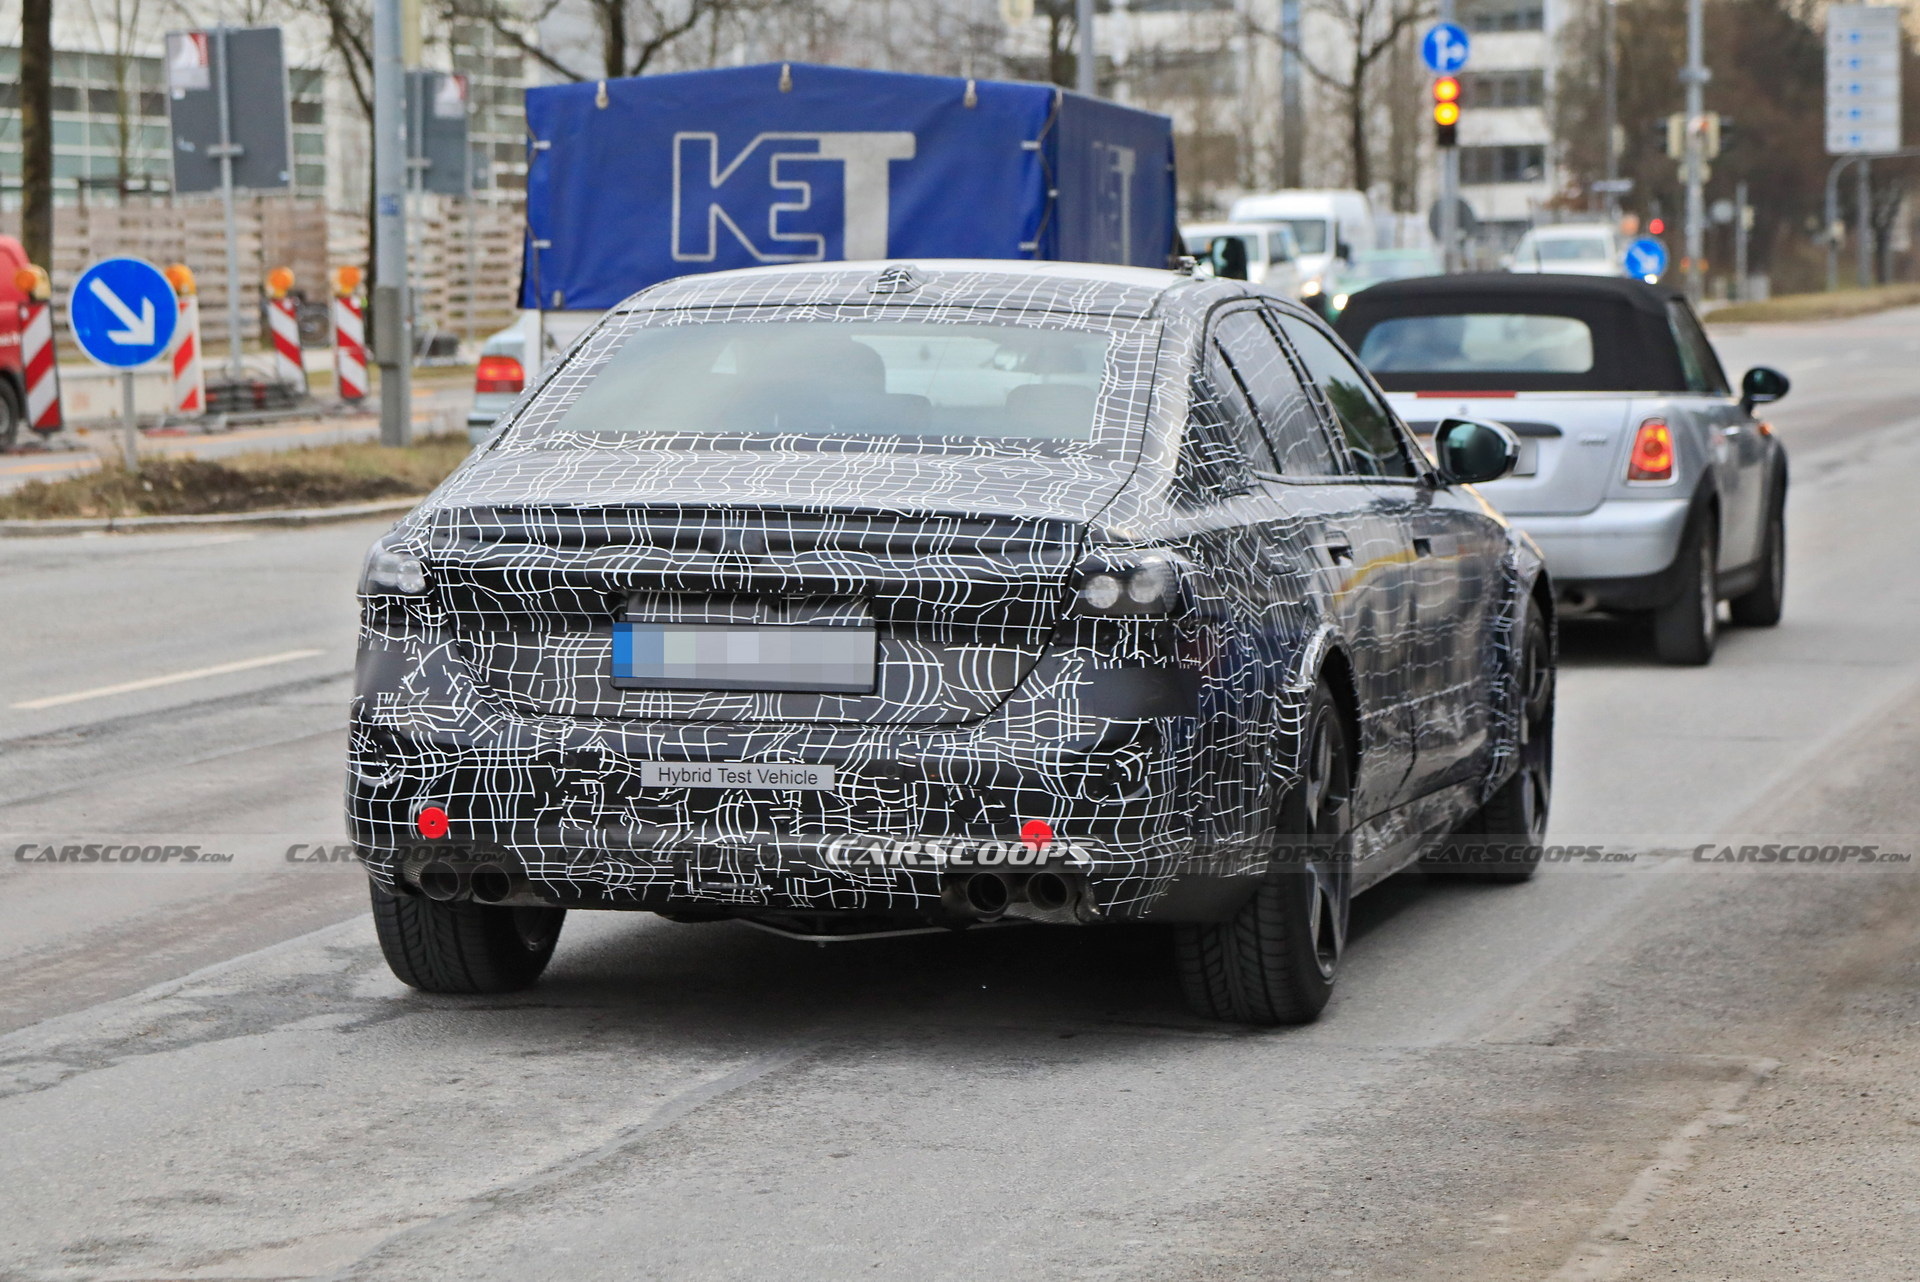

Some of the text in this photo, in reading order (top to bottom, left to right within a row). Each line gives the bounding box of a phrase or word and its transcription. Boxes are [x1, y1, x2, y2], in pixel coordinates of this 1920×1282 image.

[671, 131, 917, 261] KET
[658, 767, 818, 785] Hybrid Test Vehicle
